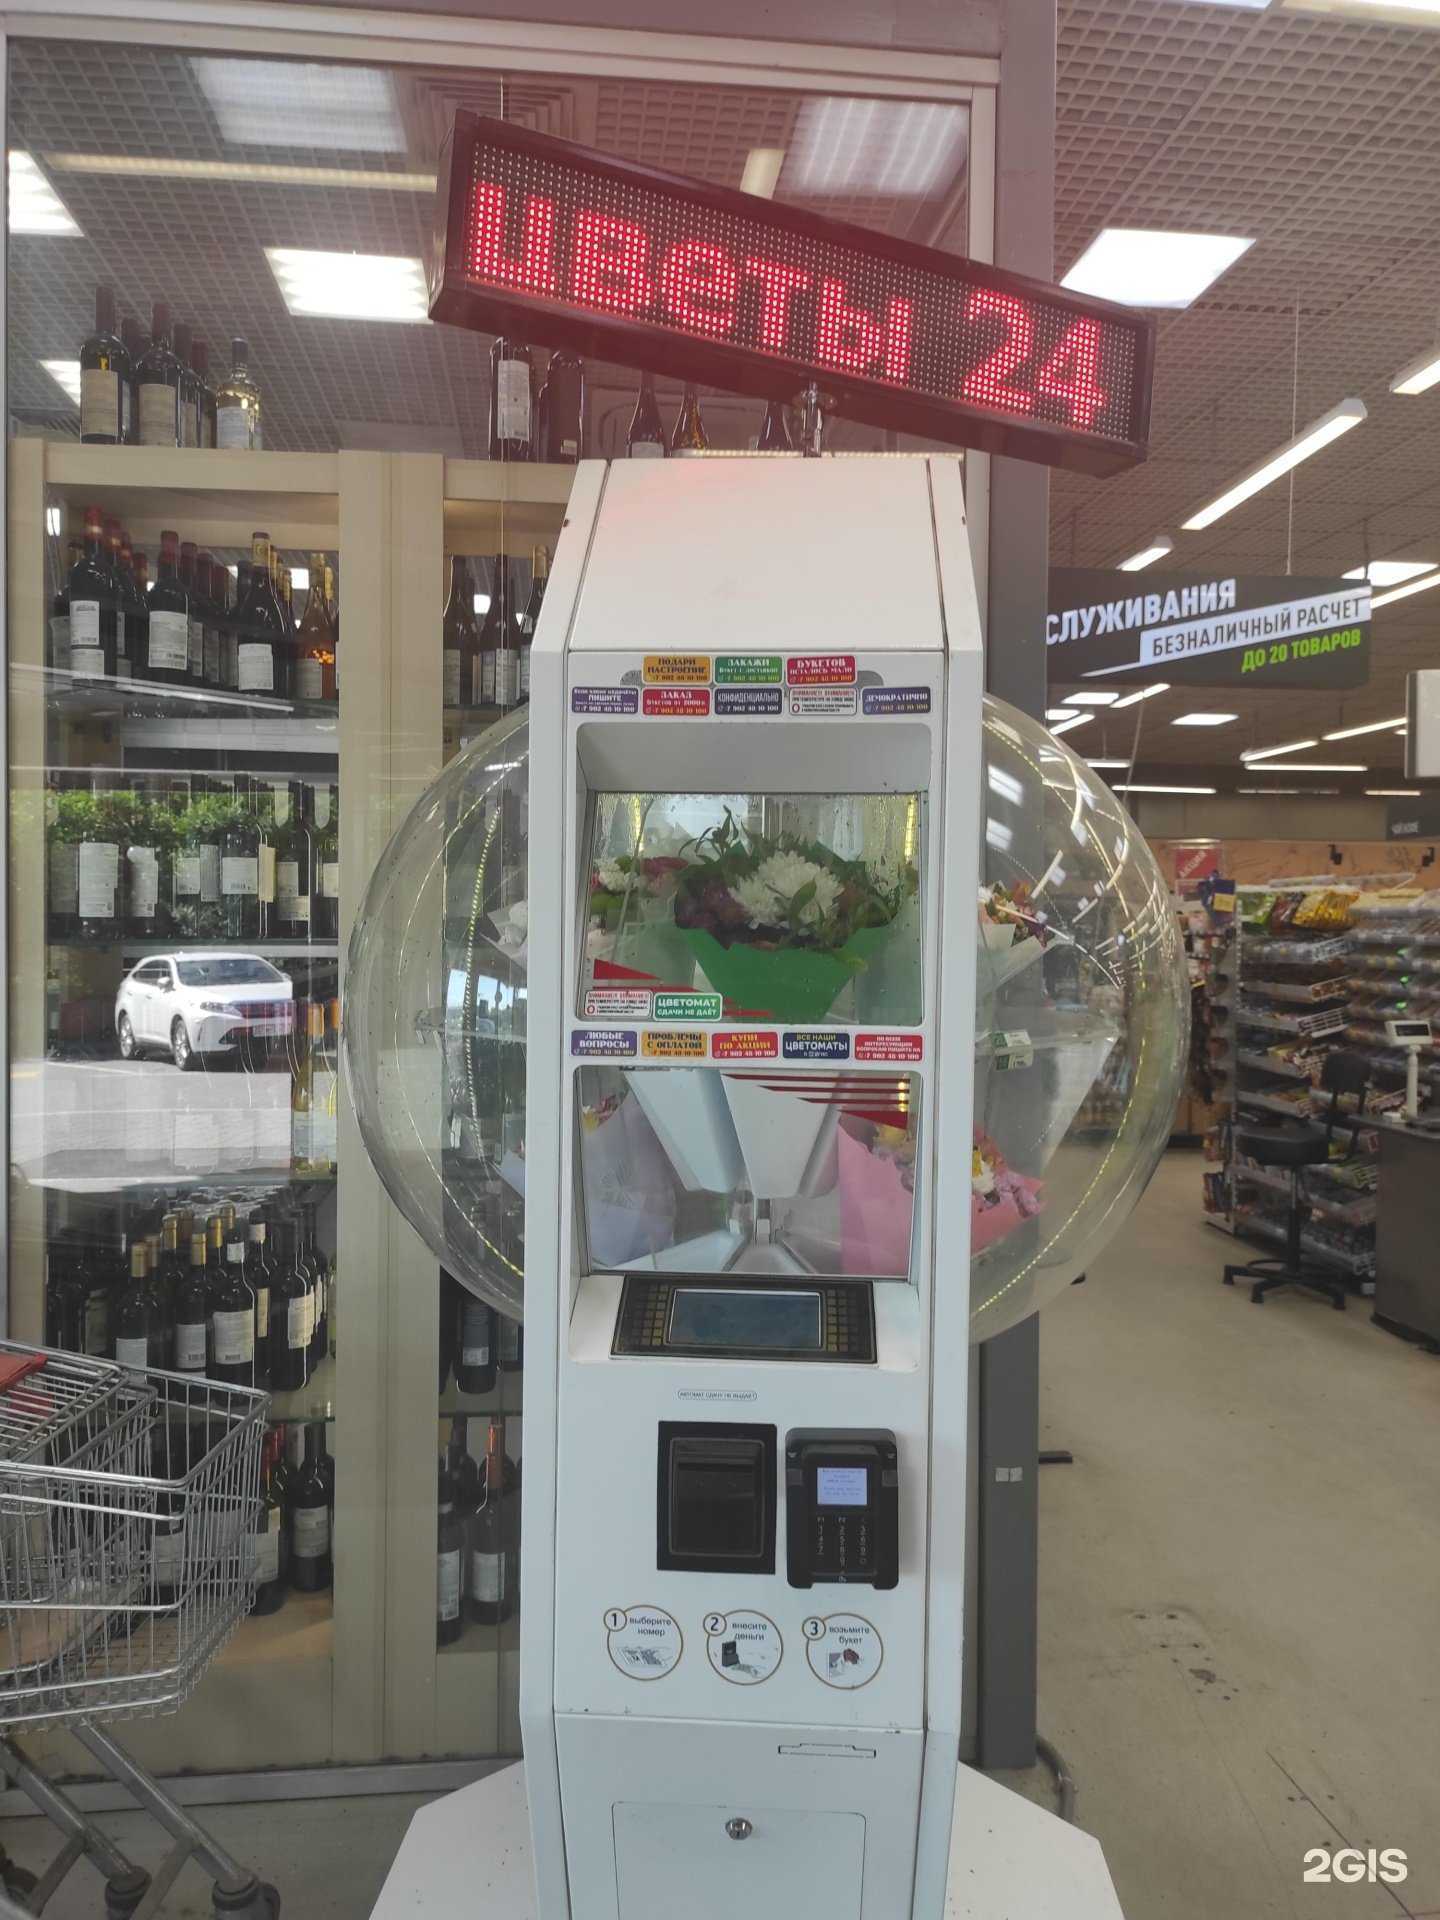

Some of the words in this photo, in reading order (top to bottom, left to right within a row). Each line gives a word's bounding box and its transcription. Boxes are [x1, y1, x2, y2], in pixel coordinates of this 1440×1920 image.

[962, 290, 1105, 426] 24
[1045, 578, 1236, 645] СЛУЖИВАНИЯ
[1153, 607, 1291, 657] БЕЗНАЛИЧНЫЙ
[1296, 598, 1360, 629] РАСЧЕТ
[1241, 648, 1266, 673] ДО
[1269, 643, 1288, 664] 20
[1291, 628, 1361, 659] ТОВАРОВ
[658, 998, 717, 1008] ЦВЕТОМАТ
[657, 1008, 684, 1017] СДАЧИ
[584, 1031, 625, 1040] ЛЮБЫЕ
[796, 1033, 811, 1041] ВСЕ
[812, 1033, 836, 1041] НАШИ
[579, 1040, 630, 1049] ВОПРОСЫ
[647, 1041, 654, 1049] С
[785, 1041, 848, 1052] ЦВЕТОМАТЫ
[610, 1612, 618, 1627] 1
[710, 1616, 719, 1632] 2
[637, 1628, 665, 1638] номер
[809, 1620, 819, 1636] 3
[734, 1633, 765, 1642] деньги
[838, 1635, 863, 1645] букет
